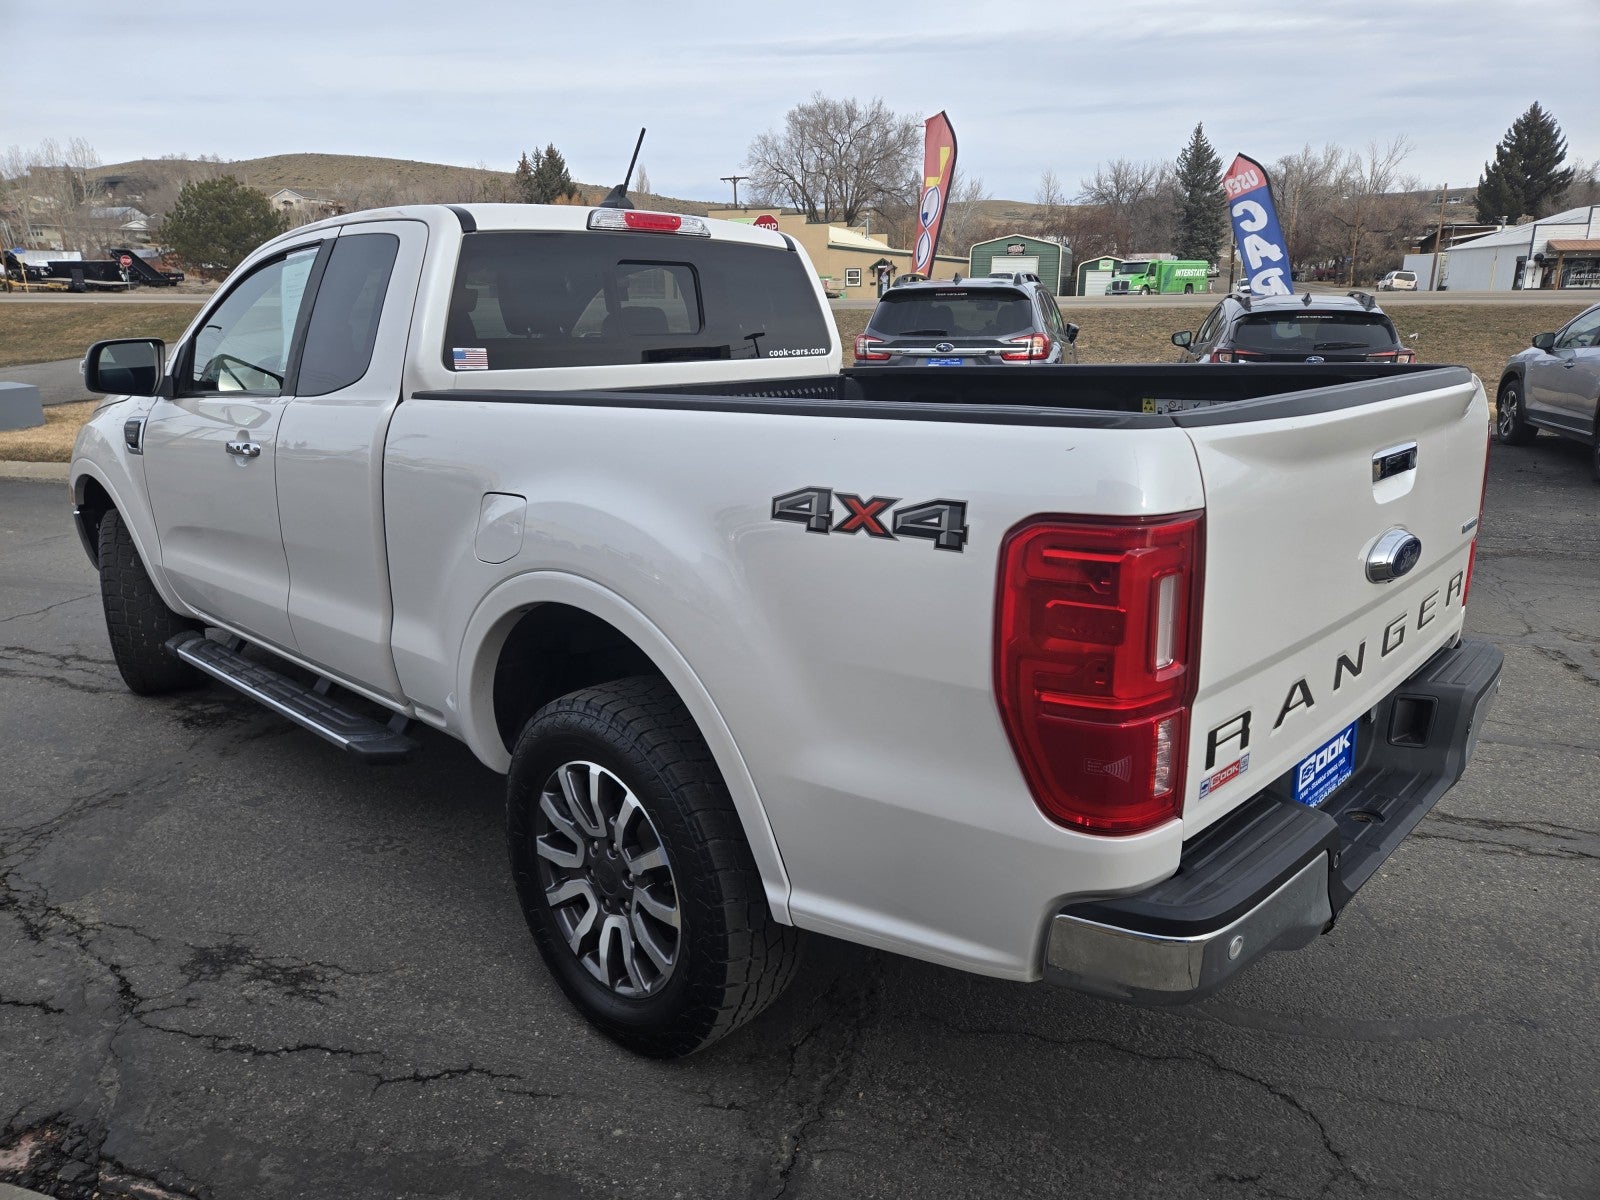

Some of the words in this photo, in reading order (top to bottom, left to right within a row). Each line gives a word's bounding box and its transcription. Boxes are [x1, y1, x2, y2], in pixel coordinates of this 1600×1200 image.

[756, 222, 778, 231] TOP
[1174, 268, 1207, 277] INTERSTATE
[769, 348, 826, 357] cook-cars.com
[1205, 571, 1463, 771] RANGER
[1298, 728, 1353, 793] COOK
